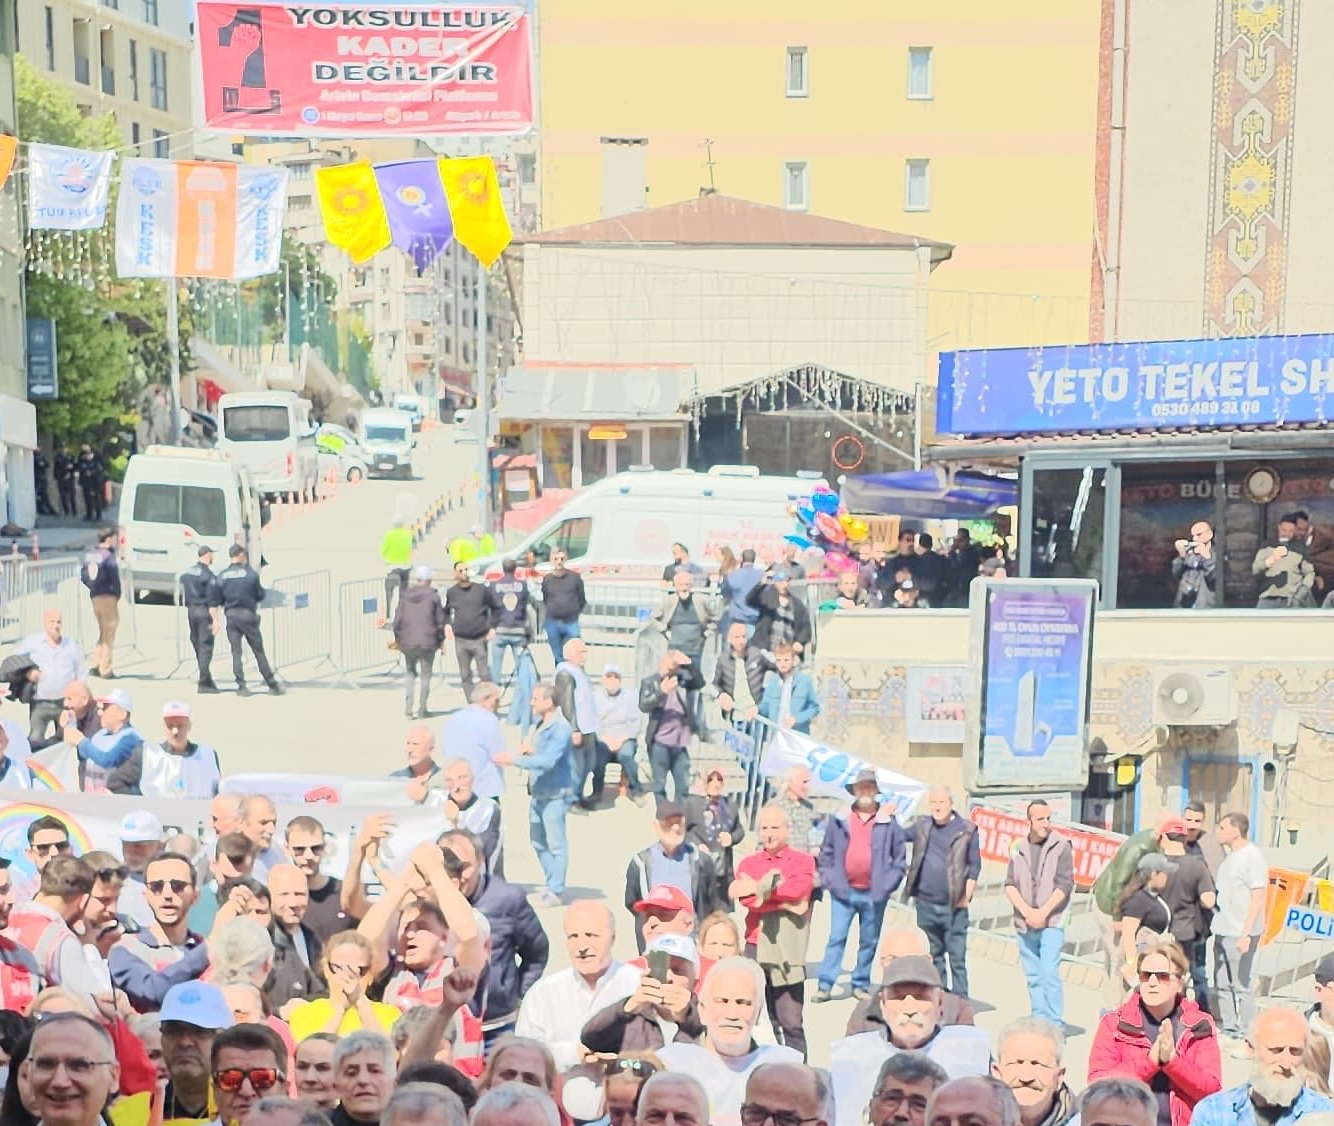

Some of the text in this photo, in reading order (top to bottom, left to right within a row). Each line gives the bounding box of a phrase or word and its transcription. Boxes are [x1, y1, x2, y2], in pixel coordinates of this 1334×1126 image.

[287, 6, 514, 29] YOKSULLUK
[337, 35, 469, 57] KADER
[315, 60, 496, 82] DEĞİLDİR
[137, 204, 155, 266] KESK
[1028, 366, 1130, 406] YETO
[1138, 360, 1271, 401] TEKEL
